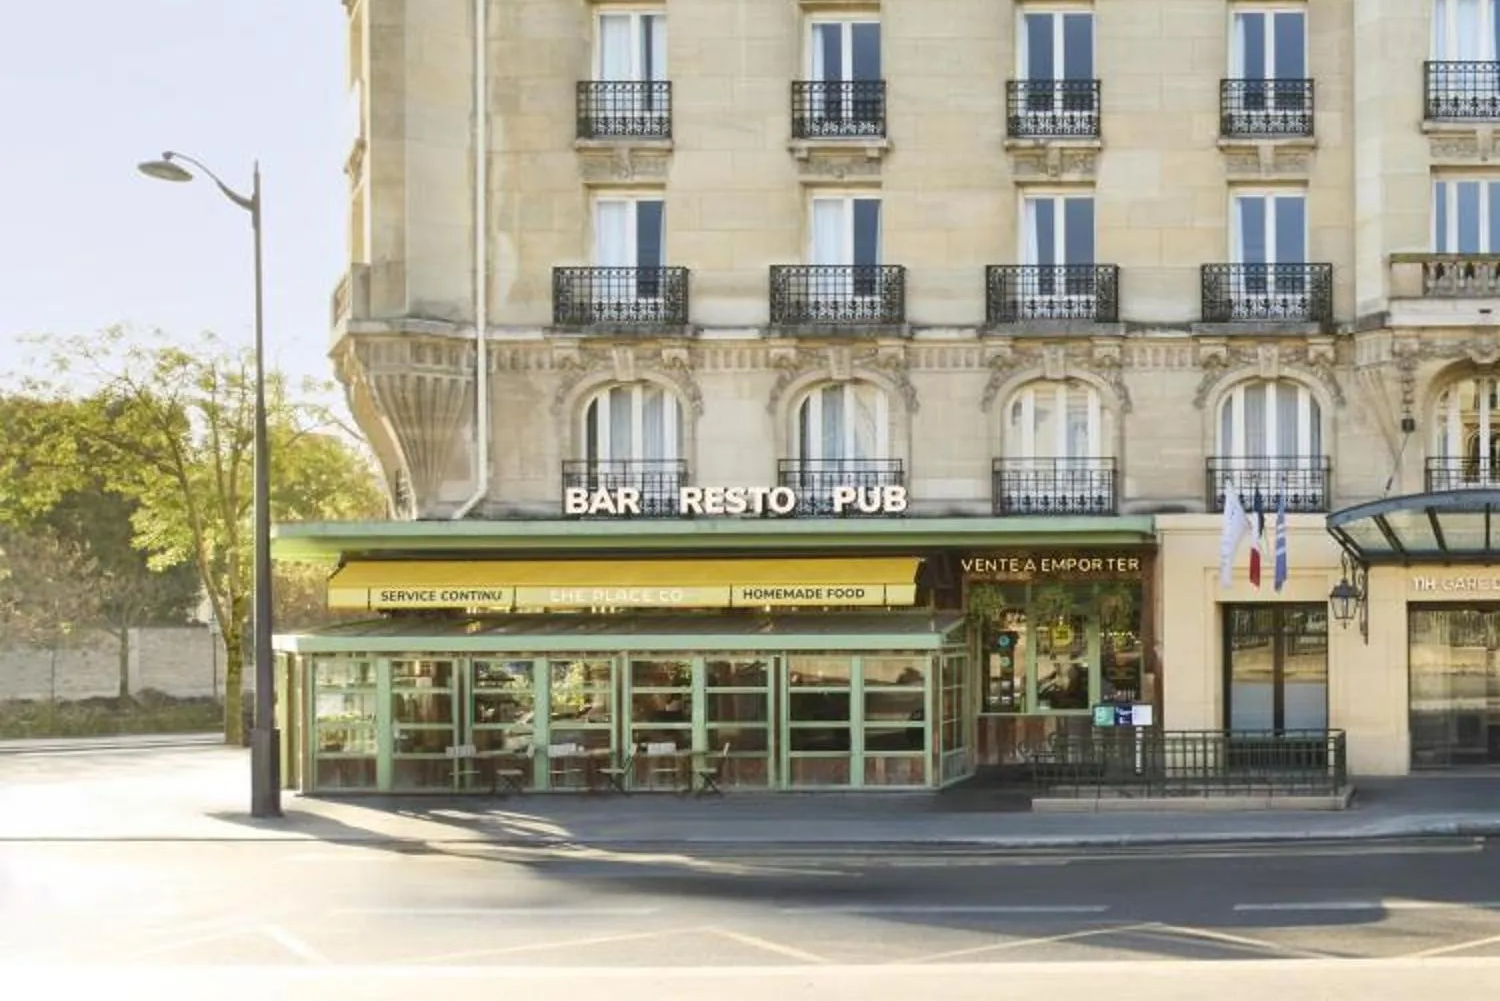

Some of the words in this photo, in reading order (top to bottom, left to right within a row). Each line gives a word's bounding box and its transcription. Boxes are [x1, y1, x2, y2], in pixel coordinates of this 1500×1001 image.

[565, 487, 641, 514] BAR
[679, 486, 796, 513] RESTO
[833, 485, 908, 512] PUB
[961, 558, 1018, 573] VENTE
[1041, 558, 1140, 572] EMPORTER
[381, 589, 436, 602] SERVICE
[440, 589, 503, 602] CONTINU
[743, 588, 823, 600] HOMEMADE
[827, 587, 865, 599] FOOD
